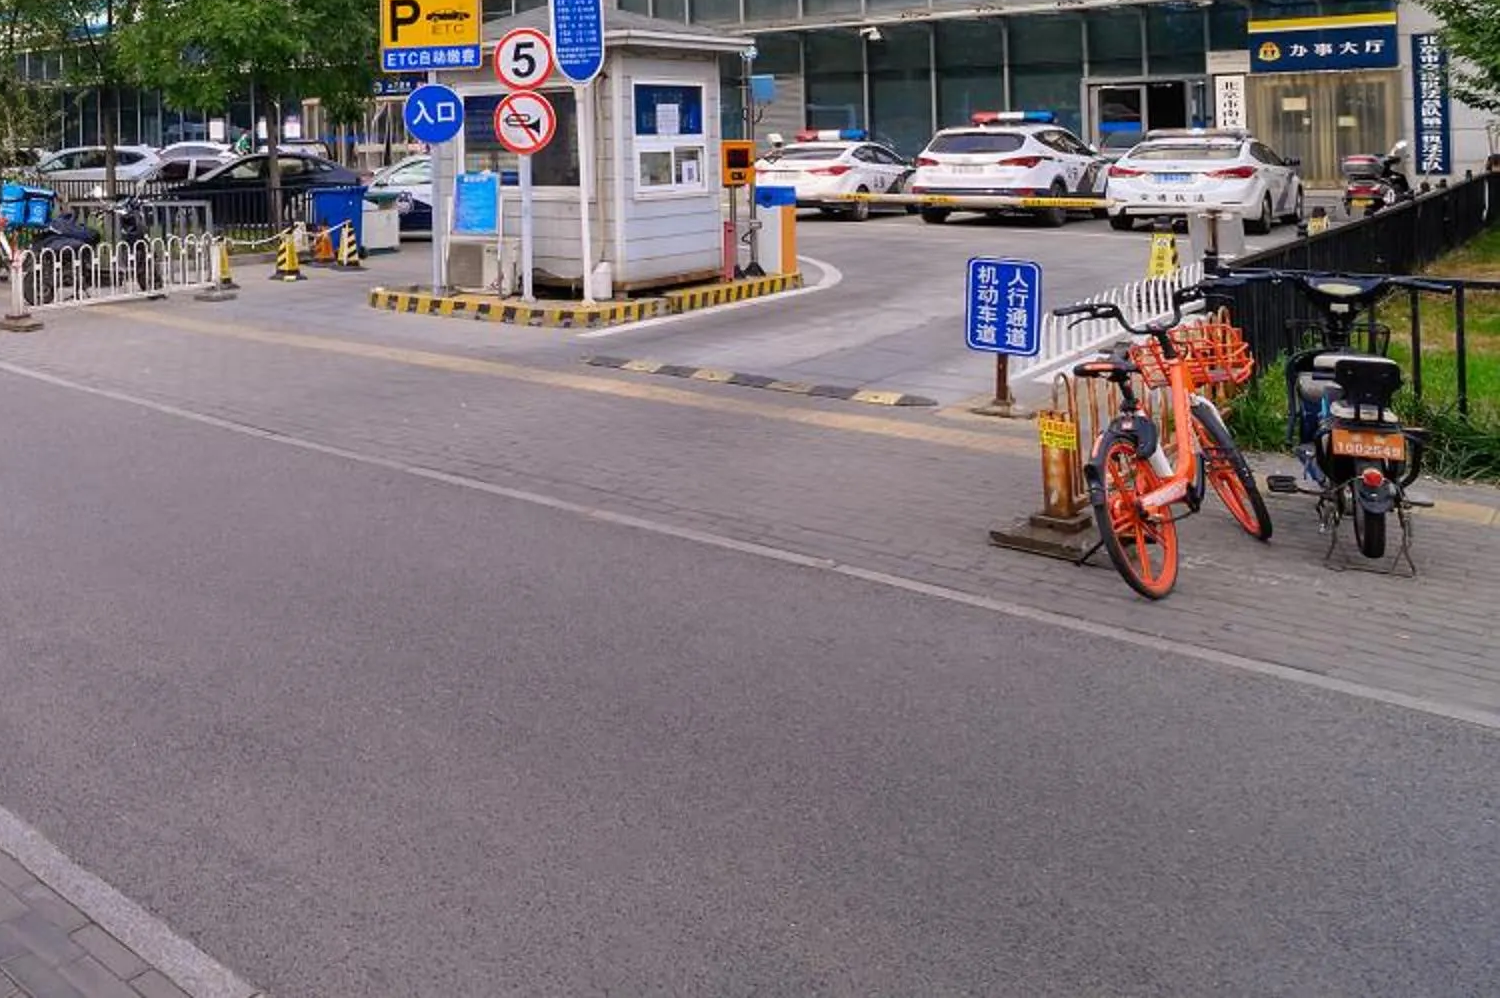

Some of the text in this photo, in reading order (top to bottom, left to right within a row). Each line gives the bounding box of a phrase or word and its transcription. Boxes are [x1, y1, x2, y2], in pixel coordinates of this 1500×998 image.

[431, 24, 465, 35] ETC
[511, 41, 536, 78] 5
[1289, 39, 1385, 58] 办事大厅
[412, 100, 456, 125] 入口
[975, 265, 999, 345] 机动车道
[1005, 267, 1029, 348] 人行通道
